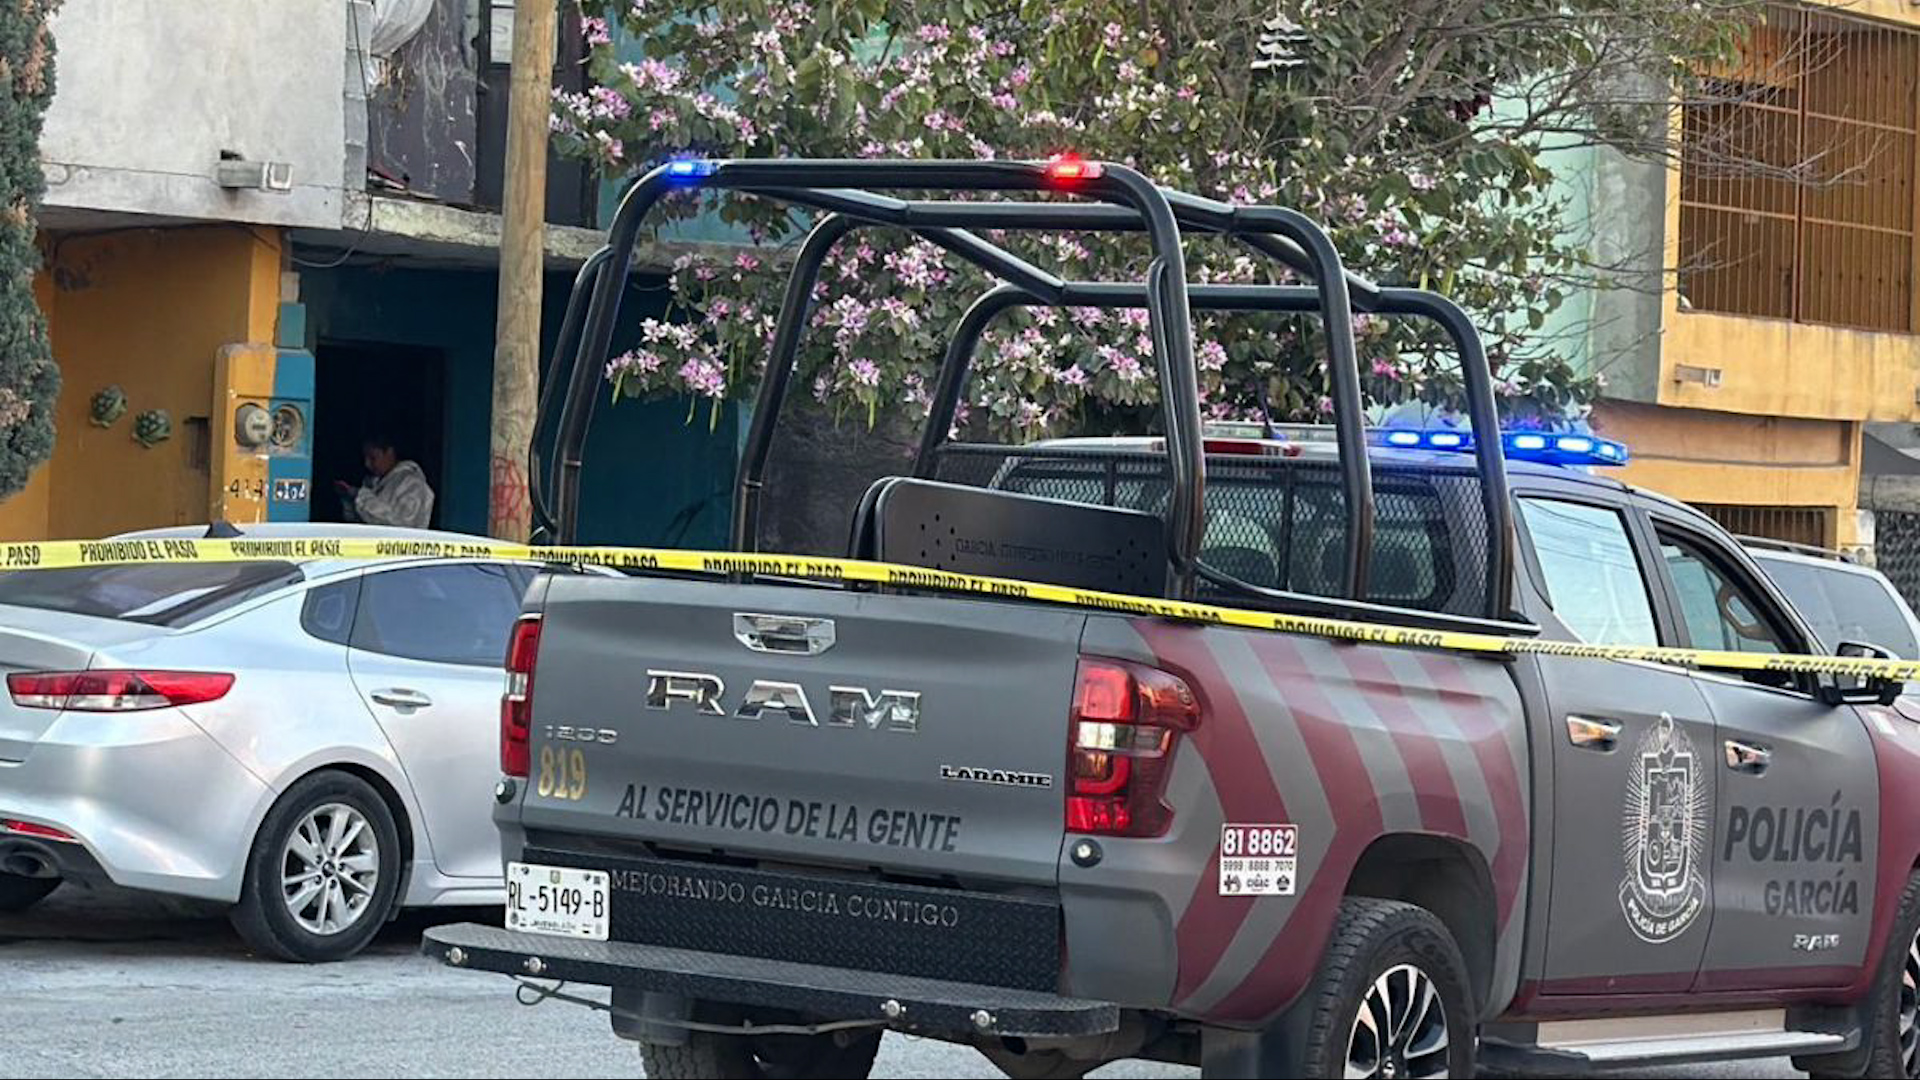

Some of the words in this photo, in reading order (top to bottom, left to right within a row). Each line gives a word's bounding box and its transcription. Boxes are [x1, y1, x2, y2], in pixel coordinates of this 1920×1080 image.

[6, 545, 40, 566] PASO
[79, 541, 147, 562] PROHIBIDO
[147, 541, 165, 559] EL
[164, 540, 198, 558] PASO
[646, 668, 921, 732] RAM
[538, 745, 586, 800] 819
[940, 765, 1052, 788] LARAMIE
[615, 784, 647, 819] AL
[655, 786, 780, 832] SERVICIO
[784, 800, 822, 837] DE
[825, 803, 858, 842] LA
[867, 809, 961, 852] GENTE
[1723, 789, 1863, 862] POLICÍA
[1224, 829, 1244, 855] 81
[1248, 829, 1295, 855] 8862
[508, 881, 604, 918] RL-5149-B
[611, 869, 745, 903] MEJORANDO
[847, 895, 958, 927] CONTIGO
[1764, 869, 1858, 916] GARCÍA
[1655, 922, 1668, 935] DE
